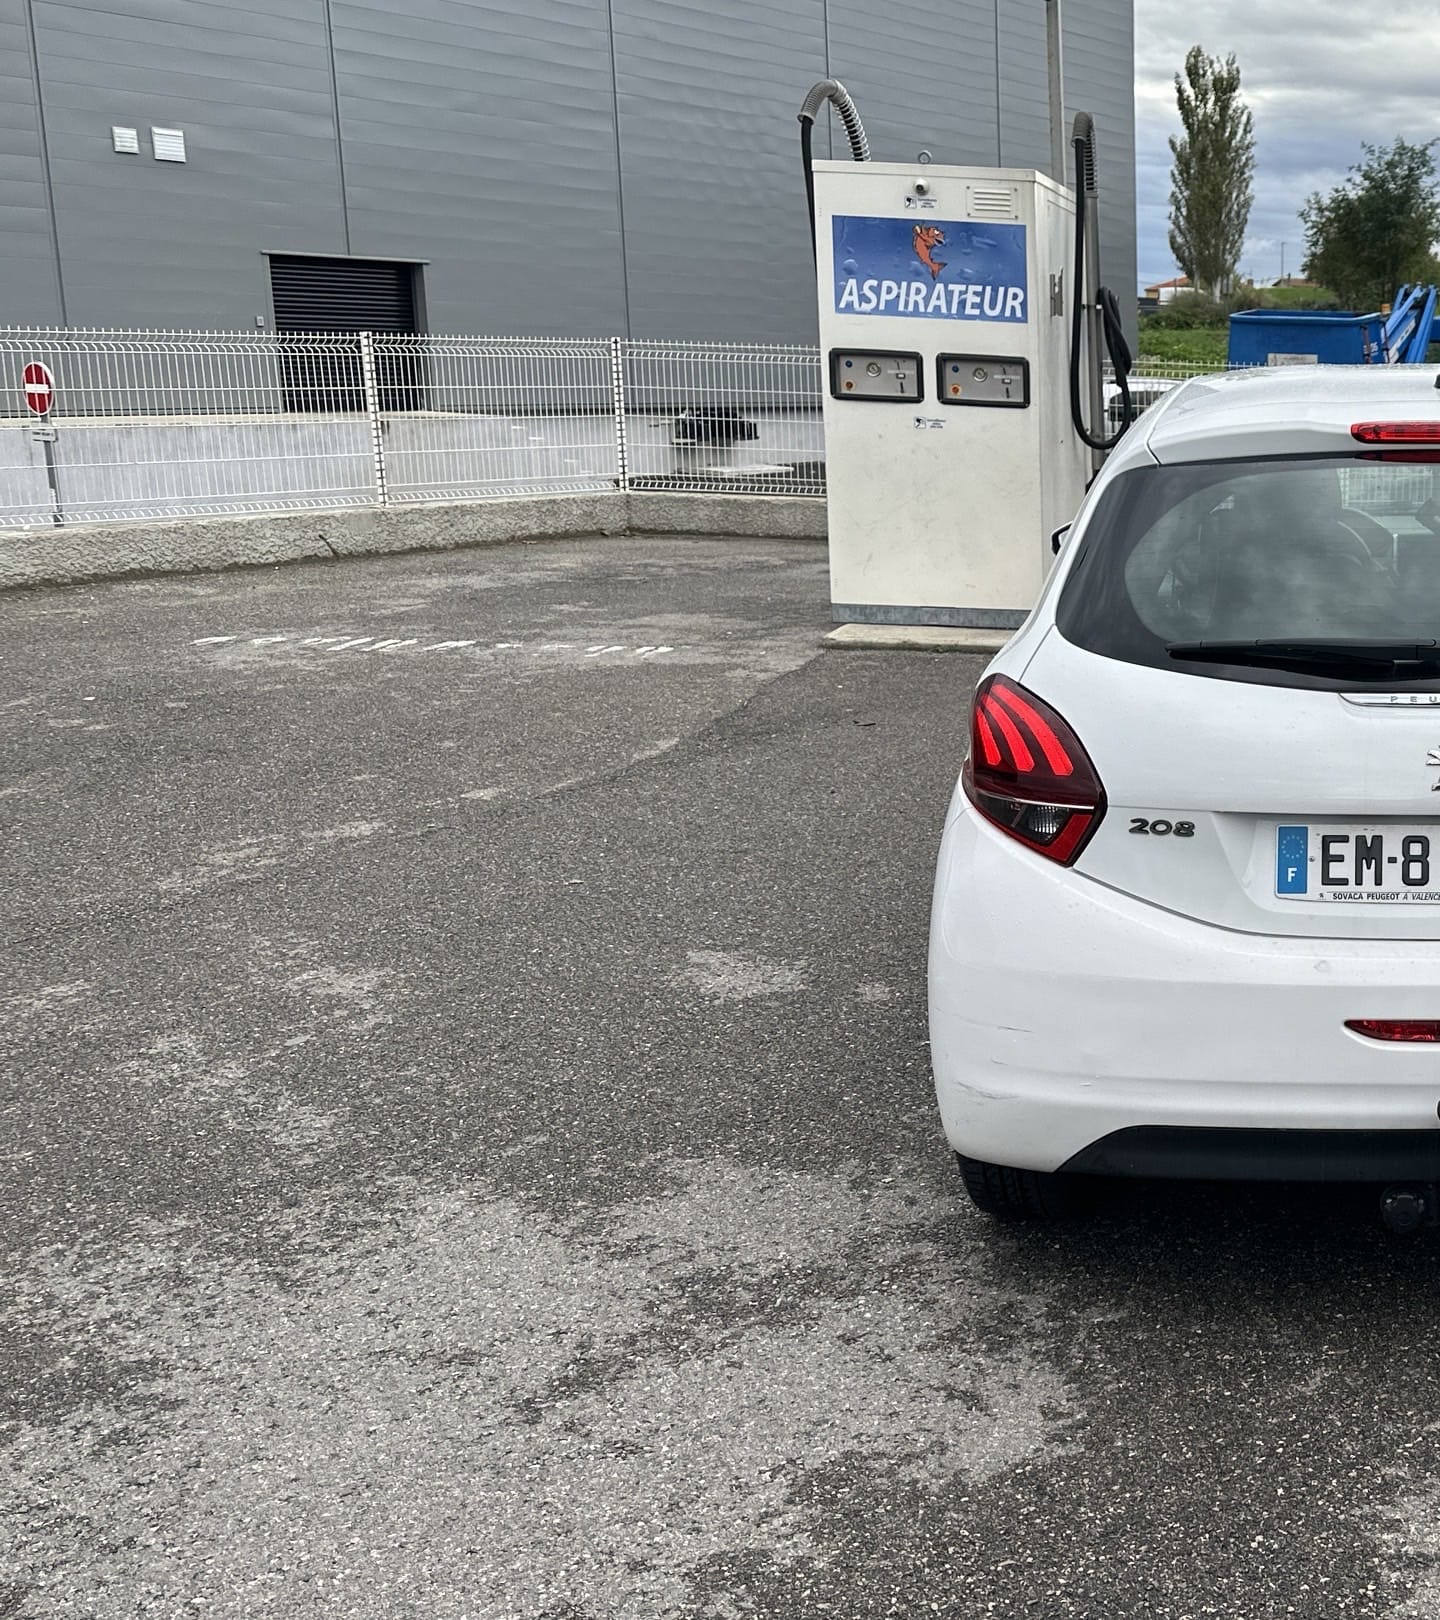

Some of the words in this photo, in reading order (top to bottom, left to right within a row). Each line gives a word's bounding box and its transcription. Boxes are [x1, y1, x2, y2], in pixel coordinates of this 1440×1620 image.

[838, 278, 1025, 318] ASPIRATEUR
[1128, 817, 1195, 837] 208
[1287, 867, 1298, 883] F
[1332, 892, 1364, 901] SOVACA
[1366, 892, 1400, 901] PEUGEOT
